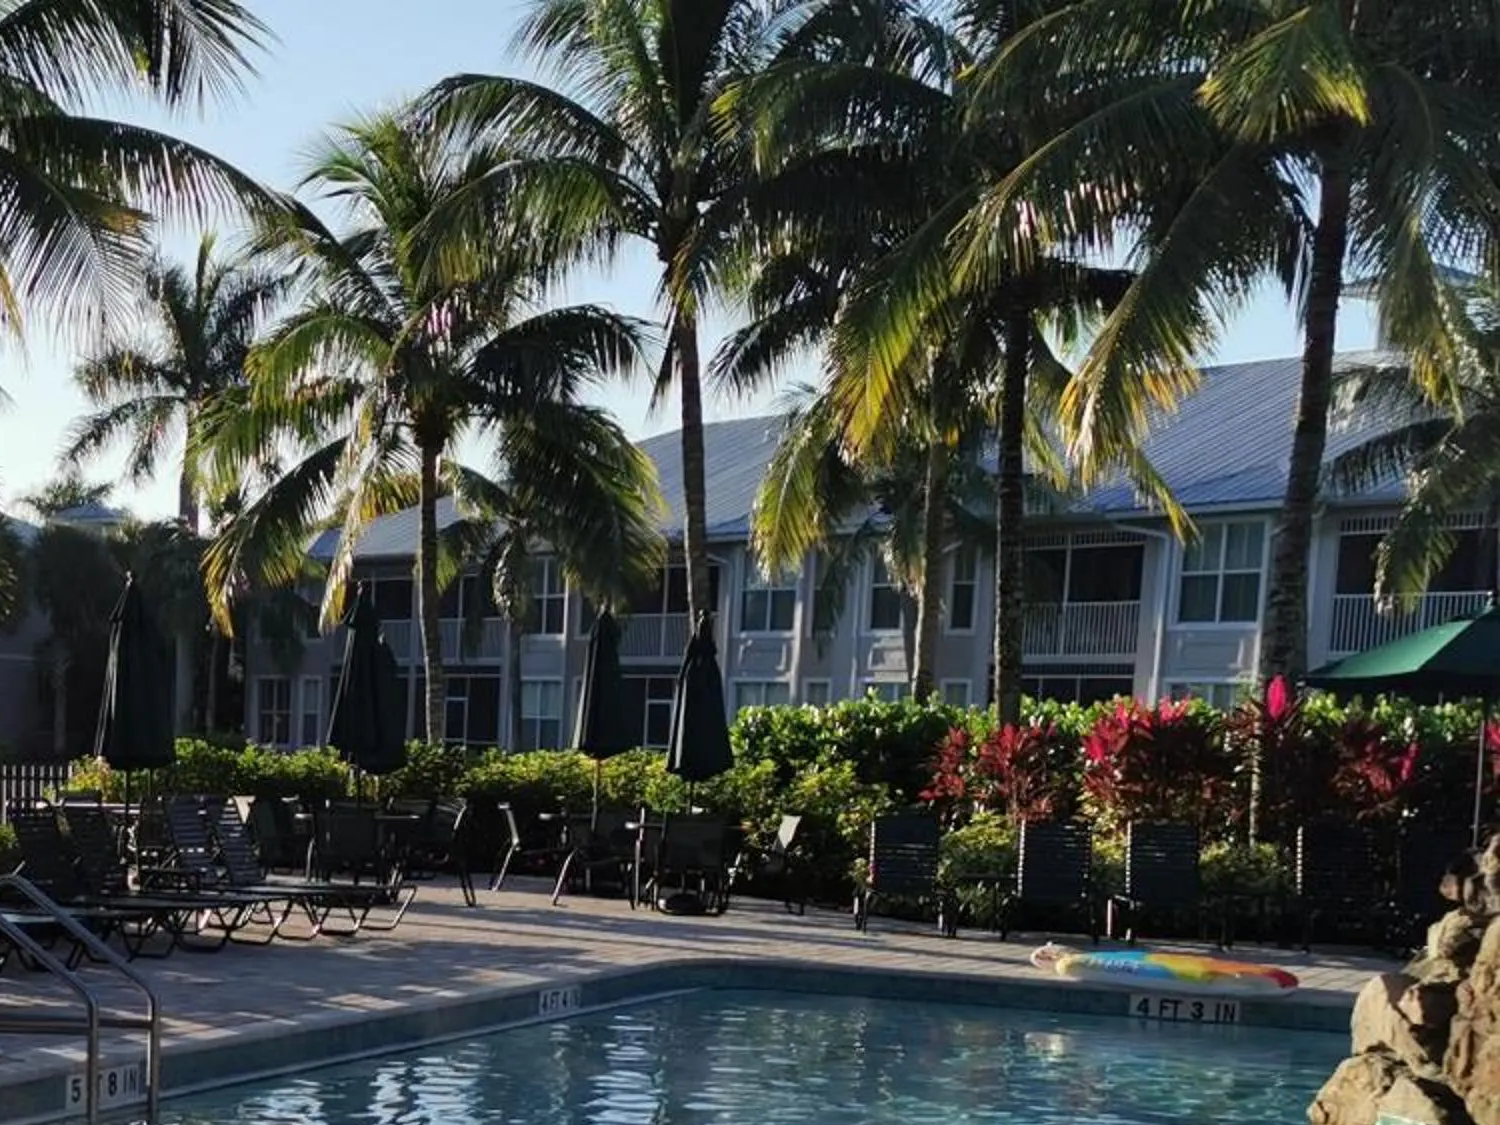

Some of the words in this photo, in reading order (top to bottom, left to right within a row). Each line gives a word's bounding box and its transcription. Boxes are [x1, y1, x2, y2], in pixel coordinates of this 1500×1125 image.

[1137, 998, 1149, 1017] 4
[1159, 998, 1183, 1020] FT
[1191, 1002, 1204, 1020] 3
[1215, 1002, 1236, 1022] IN
[71, 1078, 82, 1103] 5
[108, 1071, 118, 1097] 8
[123, 1067, 138, 1095] IN
